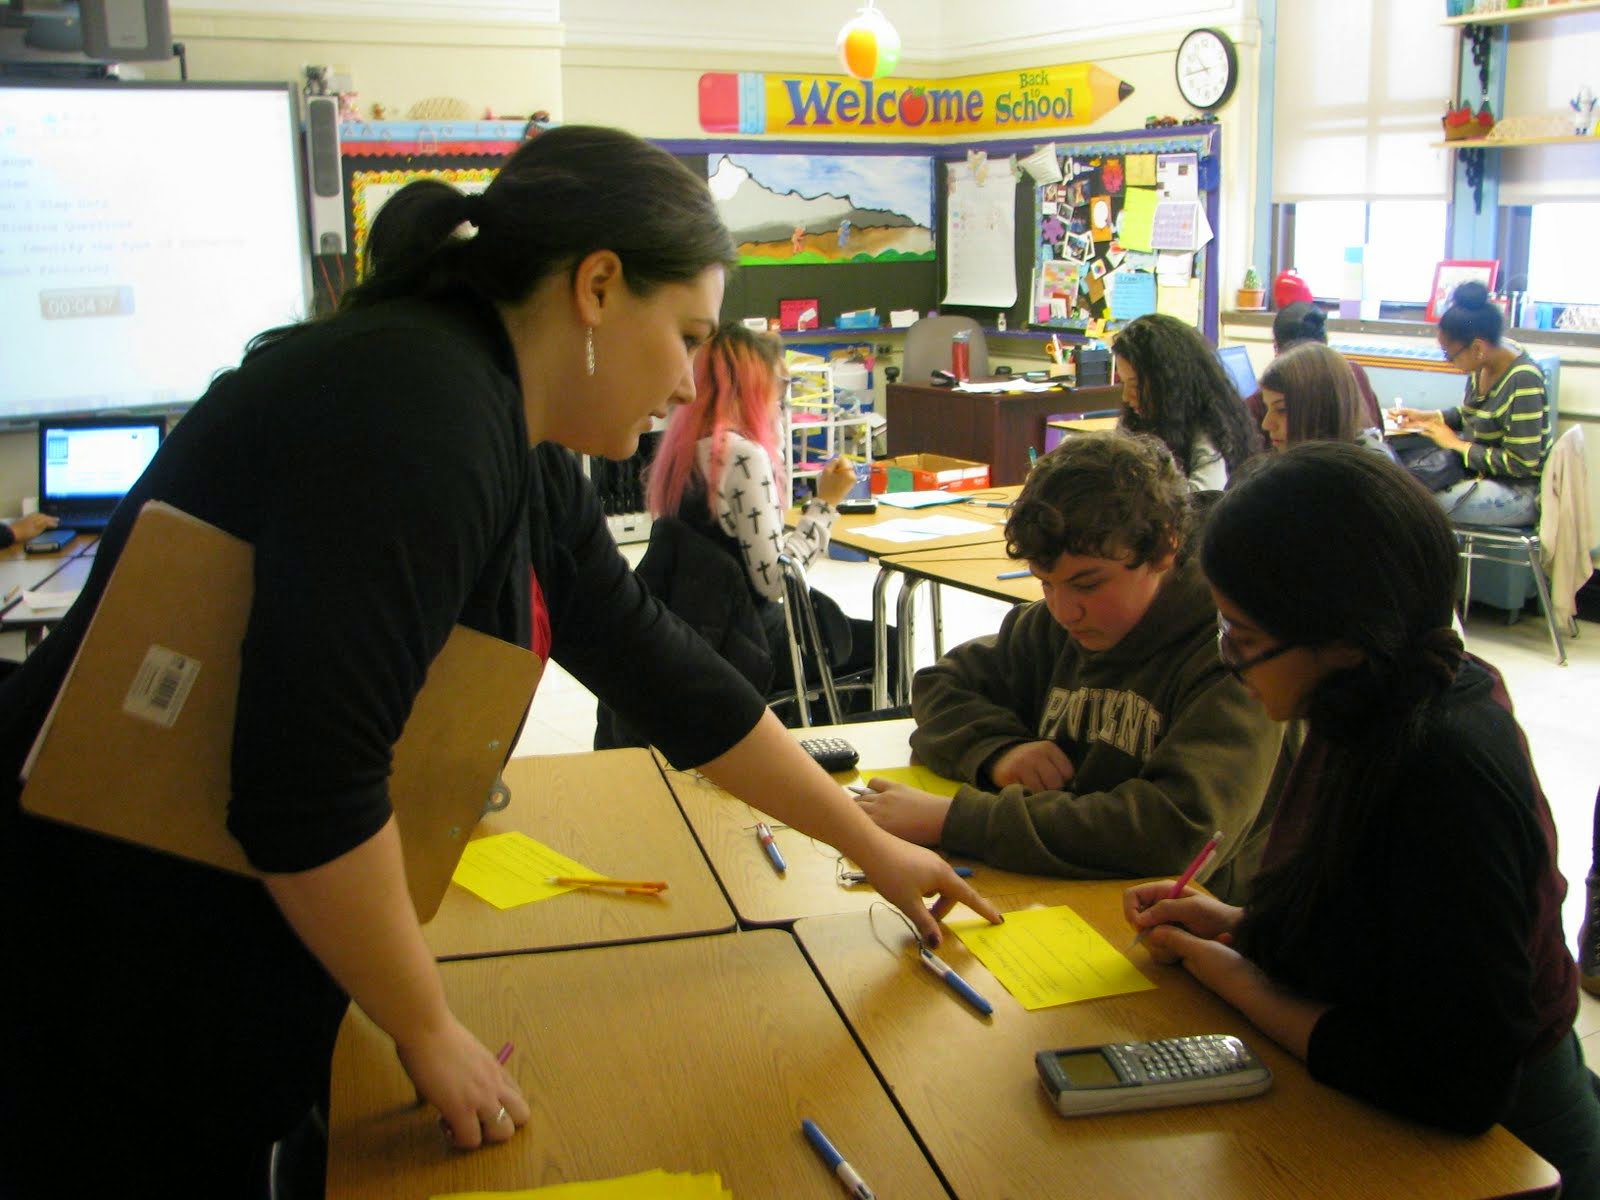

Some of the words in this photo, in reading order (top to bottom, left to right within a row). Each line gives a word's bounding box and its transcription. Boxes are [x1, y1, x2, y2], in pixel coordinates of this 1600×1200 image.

[1019, 69, 1049, 89] Back
[1030, 88, 1041, 98] to
[783, 79, 984, 127] Welcome
[995, 88, 1073, 125] School
